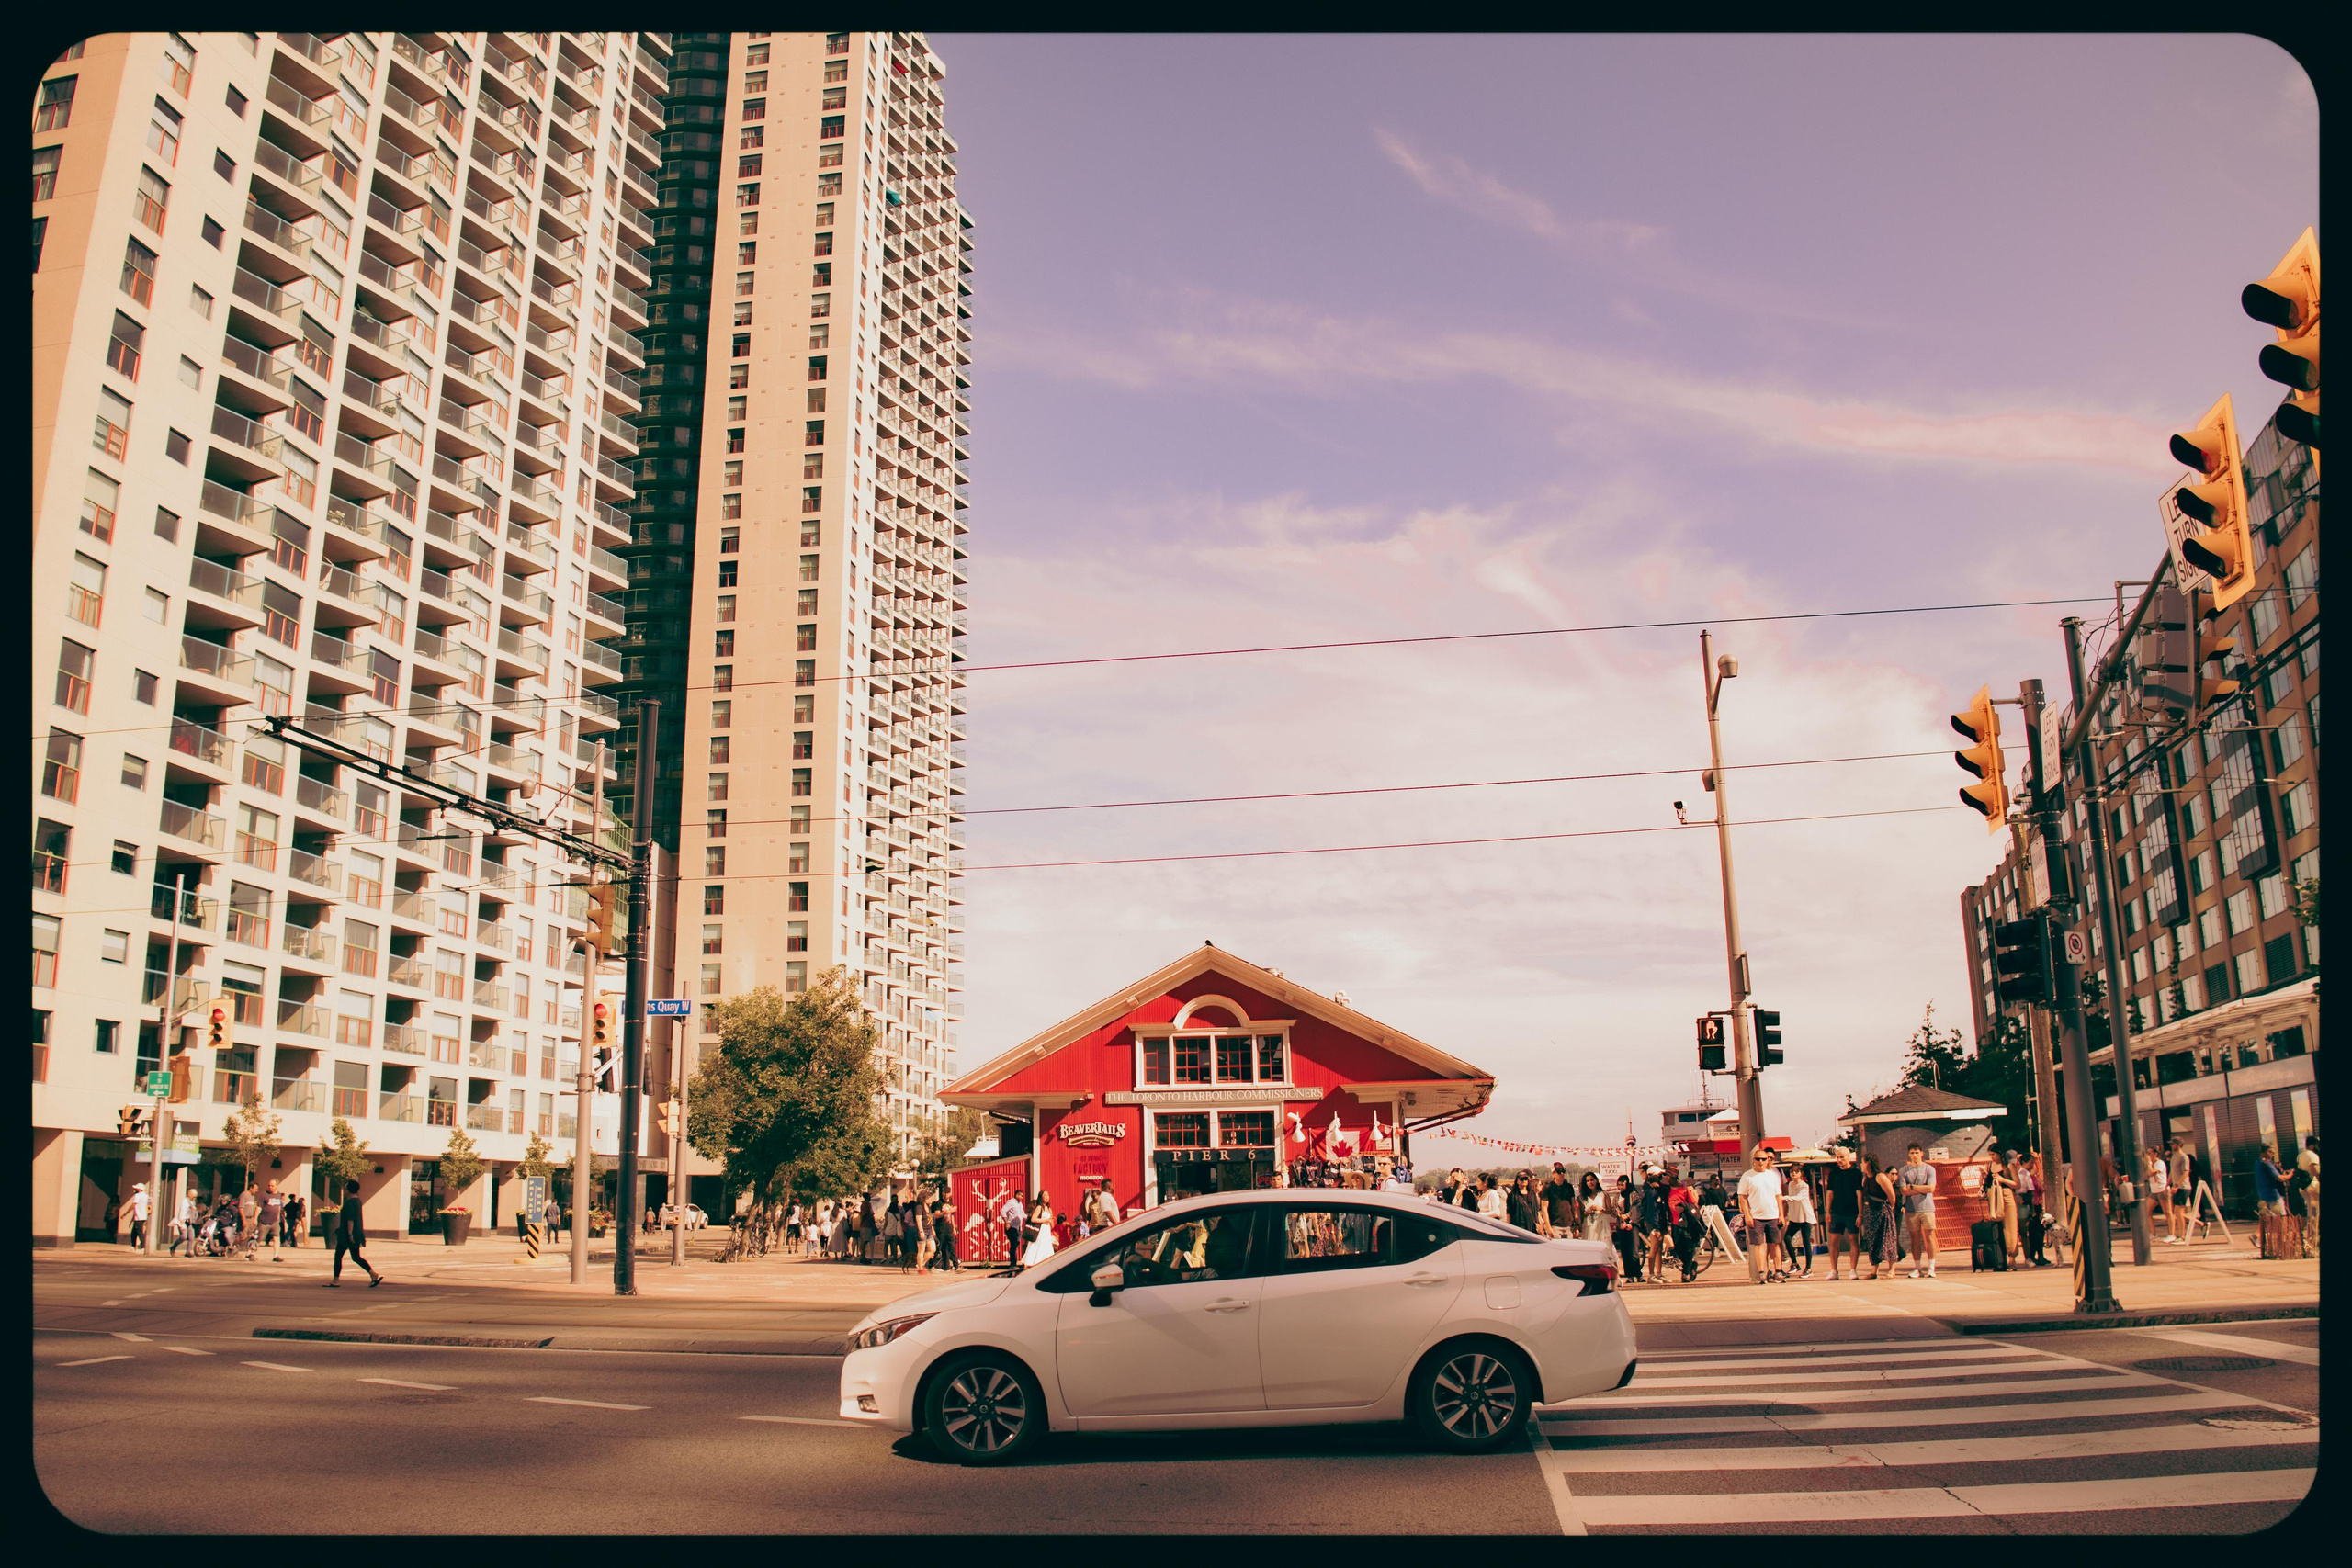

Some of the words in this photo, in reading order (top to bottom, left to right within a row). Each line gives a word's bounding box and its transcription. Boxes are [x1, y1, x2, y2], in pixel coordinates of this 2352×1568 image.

[2174, 517, 2199, 551] TURN
[2043, 710, 2054, 735] LEFT
[2044, 734, 2056, 759] TURN
[2044, 756, 2059, 784] SIGNAL
[657, 1001, 680, 1014] Quay
[681, 1001, 690, 1012] W
[1106, 1093, 1127, 1102] THE
[1131, 1092, 1181, 1101] TORONTO
[1183, 1090, 1233, 1100] HARBOUR
[1237, 1089, 1323, 1100] COMMISSIONERS
[174, 1134, 199, 1144] HARBOUR
[1172, 1150, 1230, 1161] PIER
[1248, 1149, 1256, 1160] 6
[1073, 1163, 1108, 1175] FACTORY
